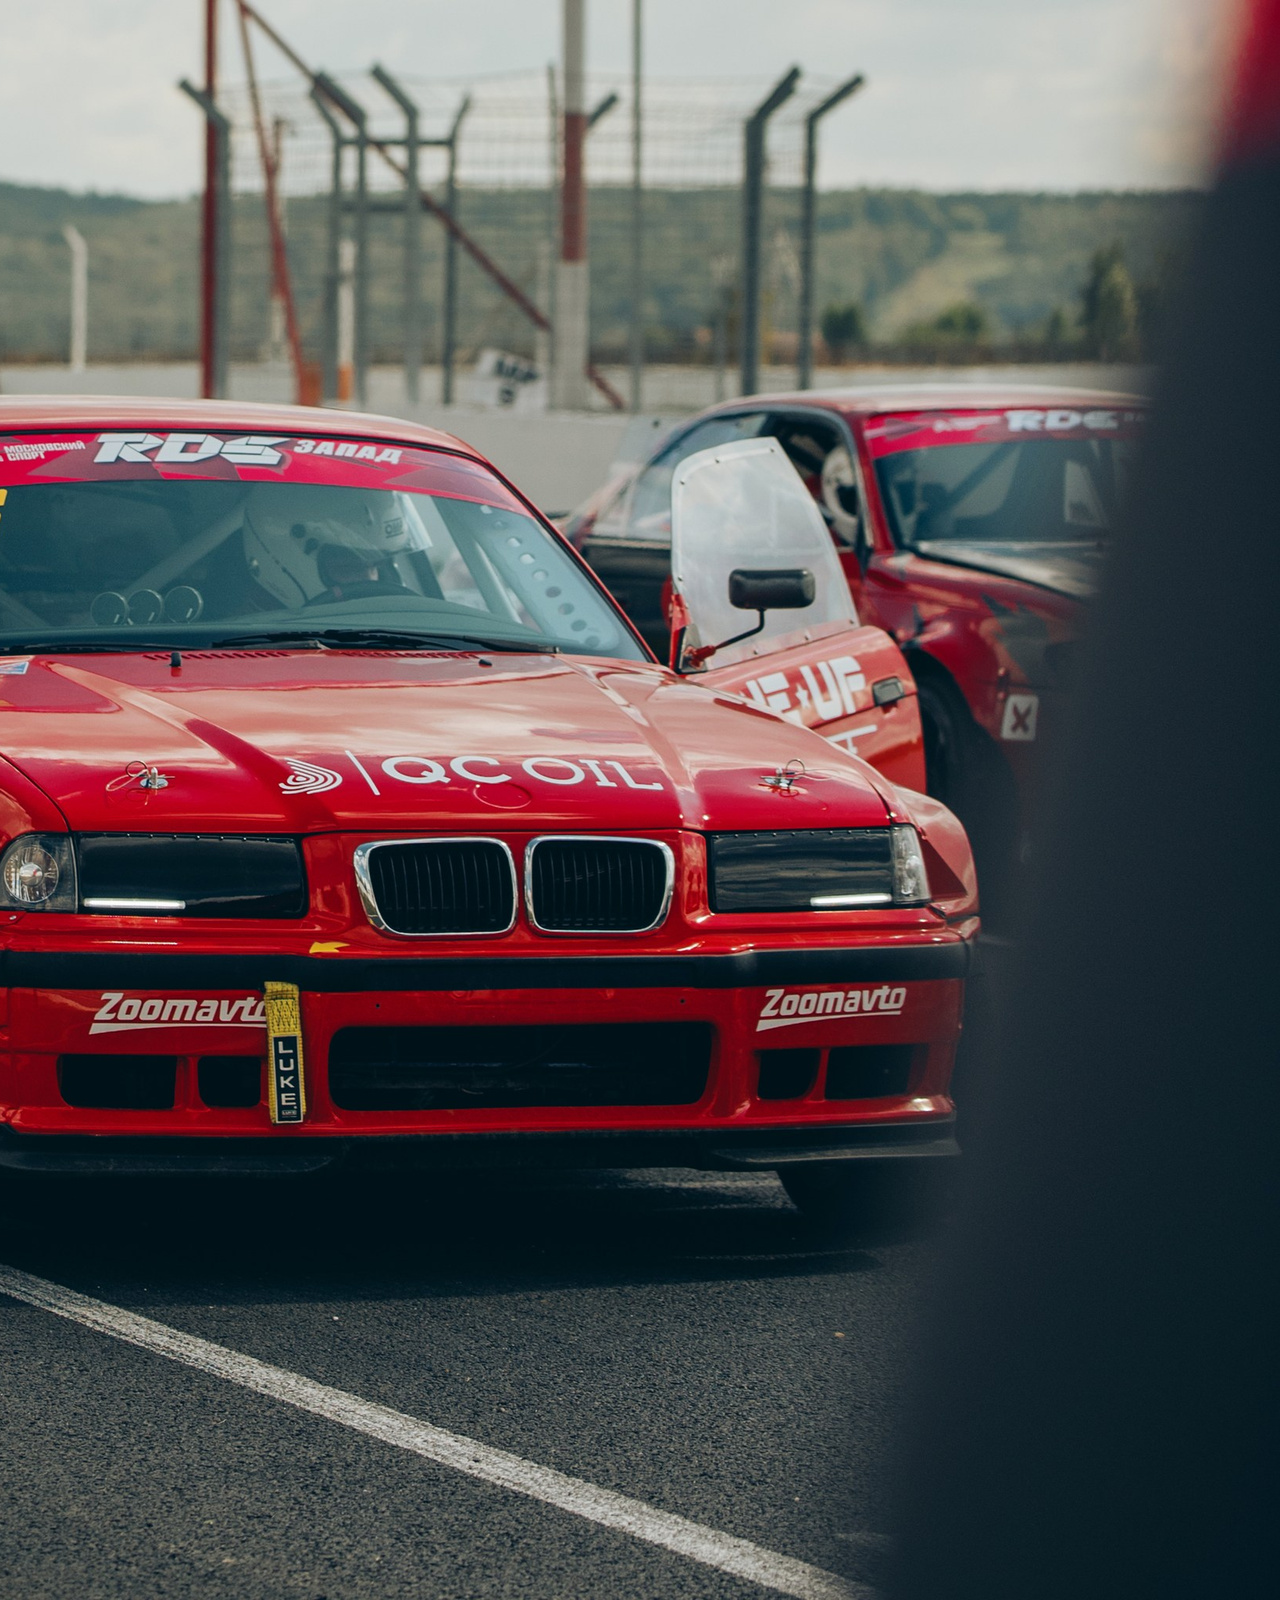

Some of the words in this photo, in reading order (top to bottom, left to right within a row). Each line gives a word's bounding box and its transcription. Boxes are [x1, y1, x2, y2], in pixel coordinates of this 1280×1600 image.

[4, 440, 86, 454] МОСКОВСКИЙ
[7, 451, 45, 462] СПОРТ
[94, 433, 292, 465] RDS
[293, 440, 403, 464] ЗАПАД
[381, 756, 512, 784] QC
[522, 757, 664, 790] OIL
[760, 985, 907, 1017] Zoomavto
